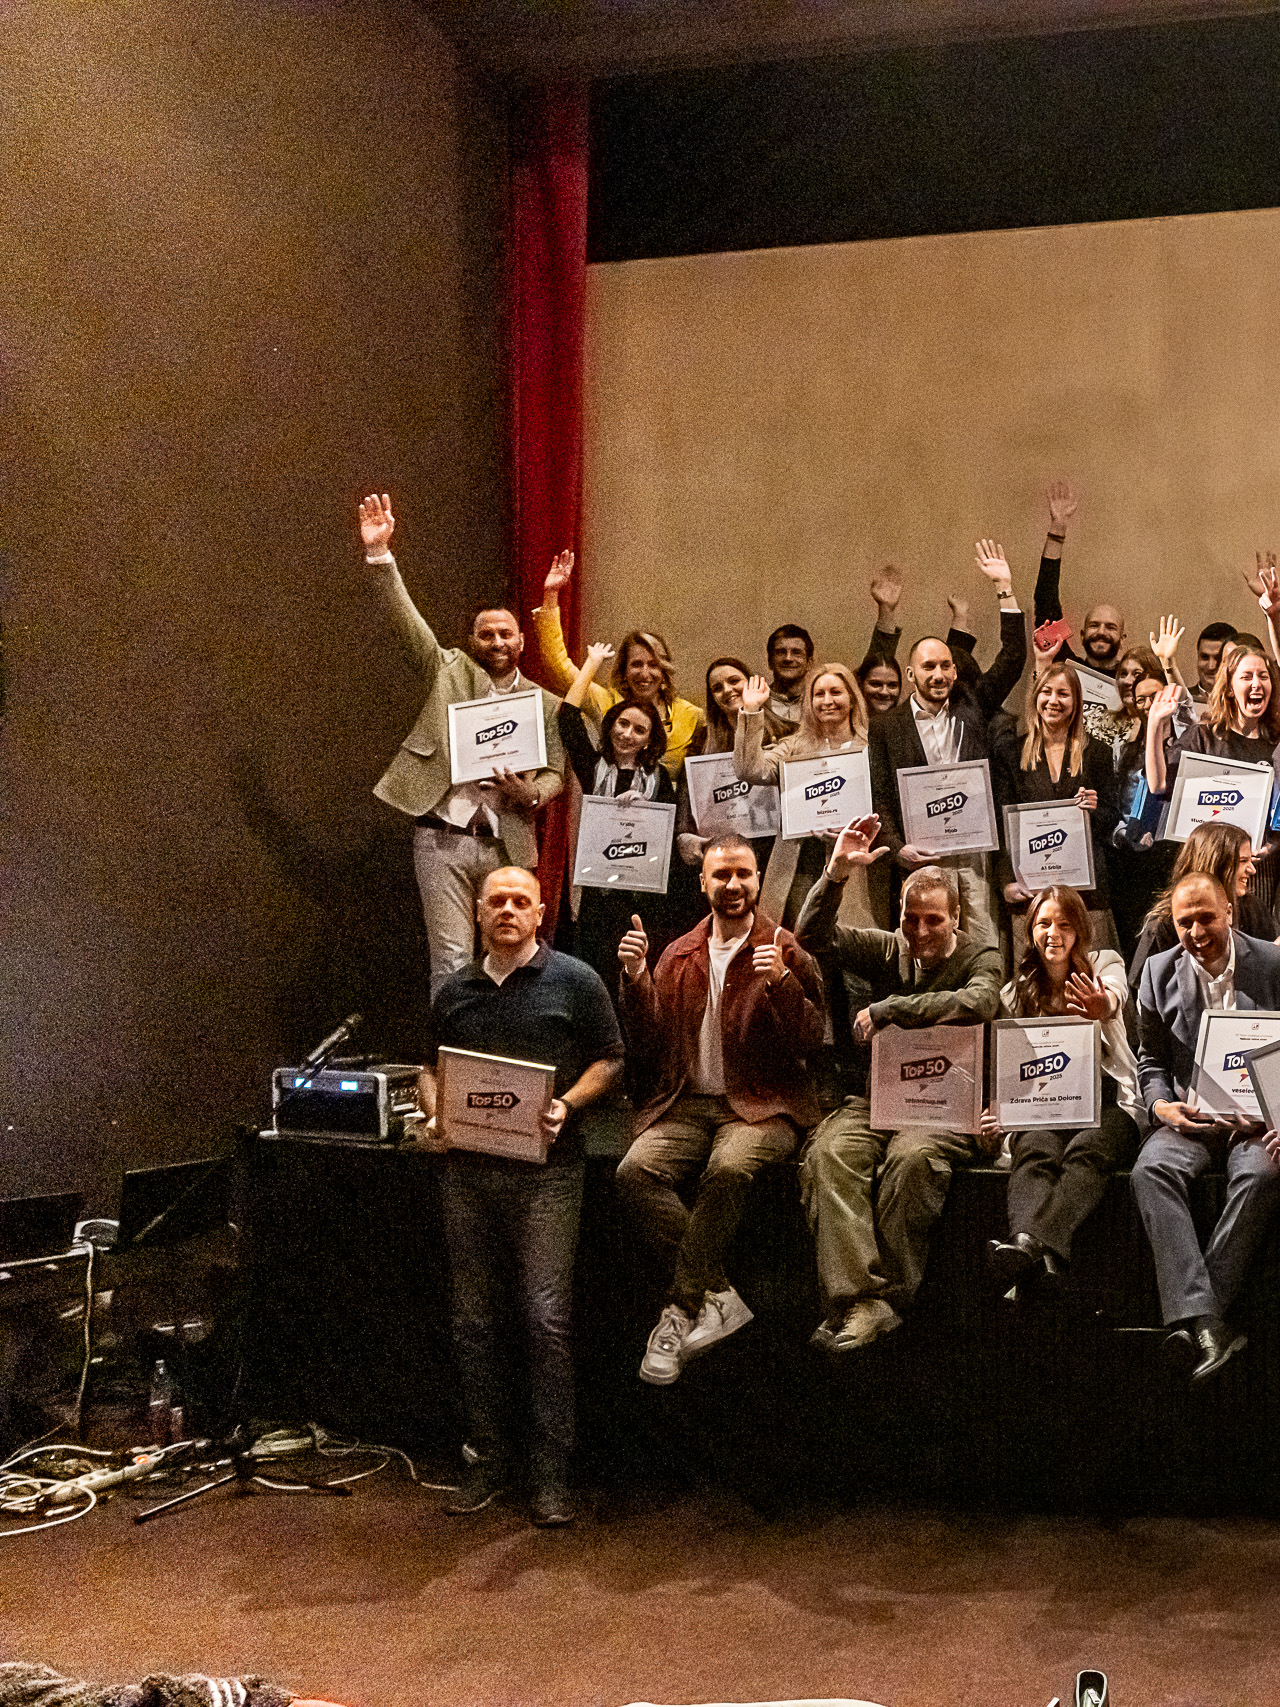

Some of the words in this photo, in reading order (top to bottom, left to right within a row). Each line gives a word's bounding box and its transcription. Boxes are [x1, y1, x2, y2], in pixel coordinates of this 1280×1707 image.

[496, 722, 514, 737] 50
[733, 781, 749, 795] 50
[825, 778, 842, 792] 50
[946, 794, 963, 810] 50
[1220, 792, 1239, 804] 50
[1048, 831, 1063, 846] 50
[926, 1059, 945, 1075] 50
[1044, 1055, 1064, 1073] 50
[1050, 1073, 1063, 1081] 2025
[492, 1093, 513, 1107] 50
